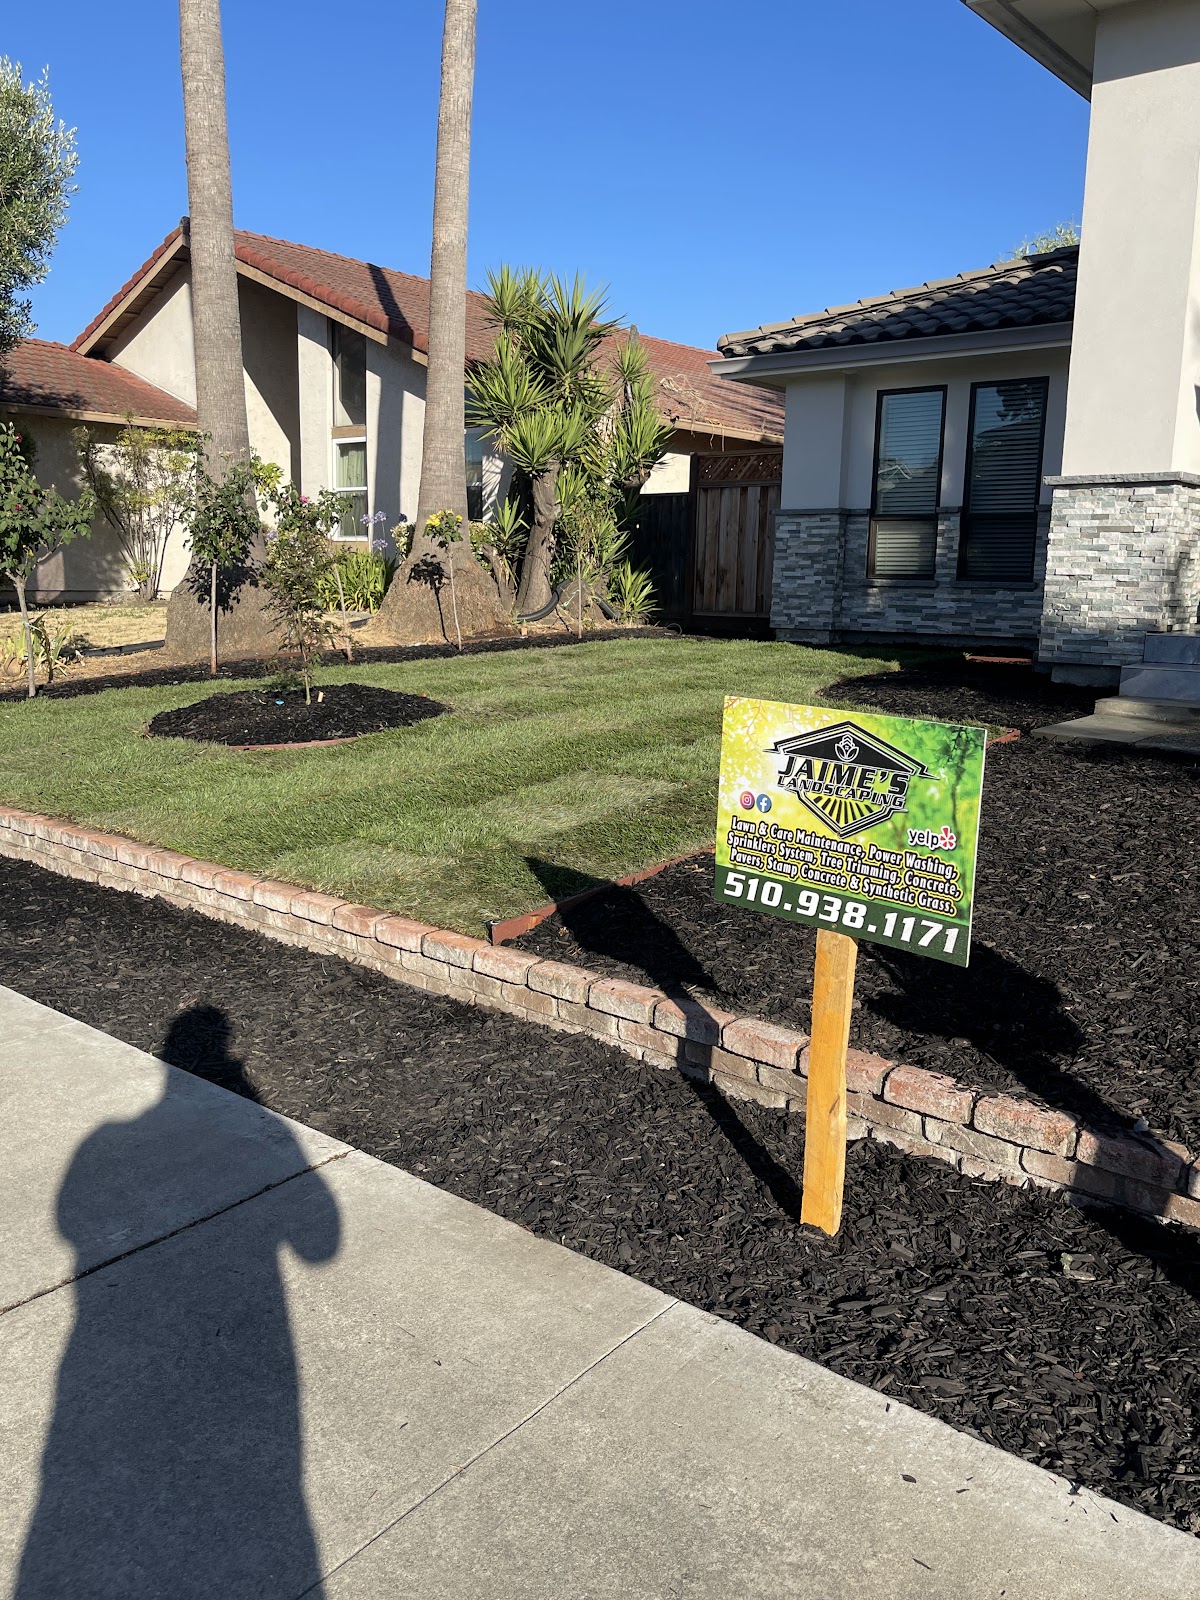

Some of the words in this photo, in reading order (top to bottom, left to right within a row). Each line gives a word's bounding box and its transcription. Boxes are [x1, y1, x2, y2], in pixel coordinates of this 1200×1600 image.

[777, 774, 906, 809] LANDSCAPING
[778, 756, 910, 795] JAIME'S
[727, 831, 777, 856] Sprinklers
[779, 842, 817, 864] System,
[820, 851, 844, 869] Tree
[846, 857, 901, 884] Trimming,
[904, 871, 961, 897] Concrete,
[732, 816, 756, 834] Lawn
[758, 821, 768, 836] &
[770, 823, 794, 841] Care
[796, 828, 866, 859] Maintenance,
[868, 843, 902, 866] Power
[905, 851, 957, 879] Washing,
[909, 830, 939, 848] yelp
[730, 847, 765, 868] Pavers,
[766, 856, 798, 877] Stamp
[800, 864, 847, 888] Concrete
[849, 875, 860, 890] &
[862, 878, 915, 903] Synthetic
[918, 891, 955, 914] Grass.
[723, 871, 960, 954] 510.938.1171
